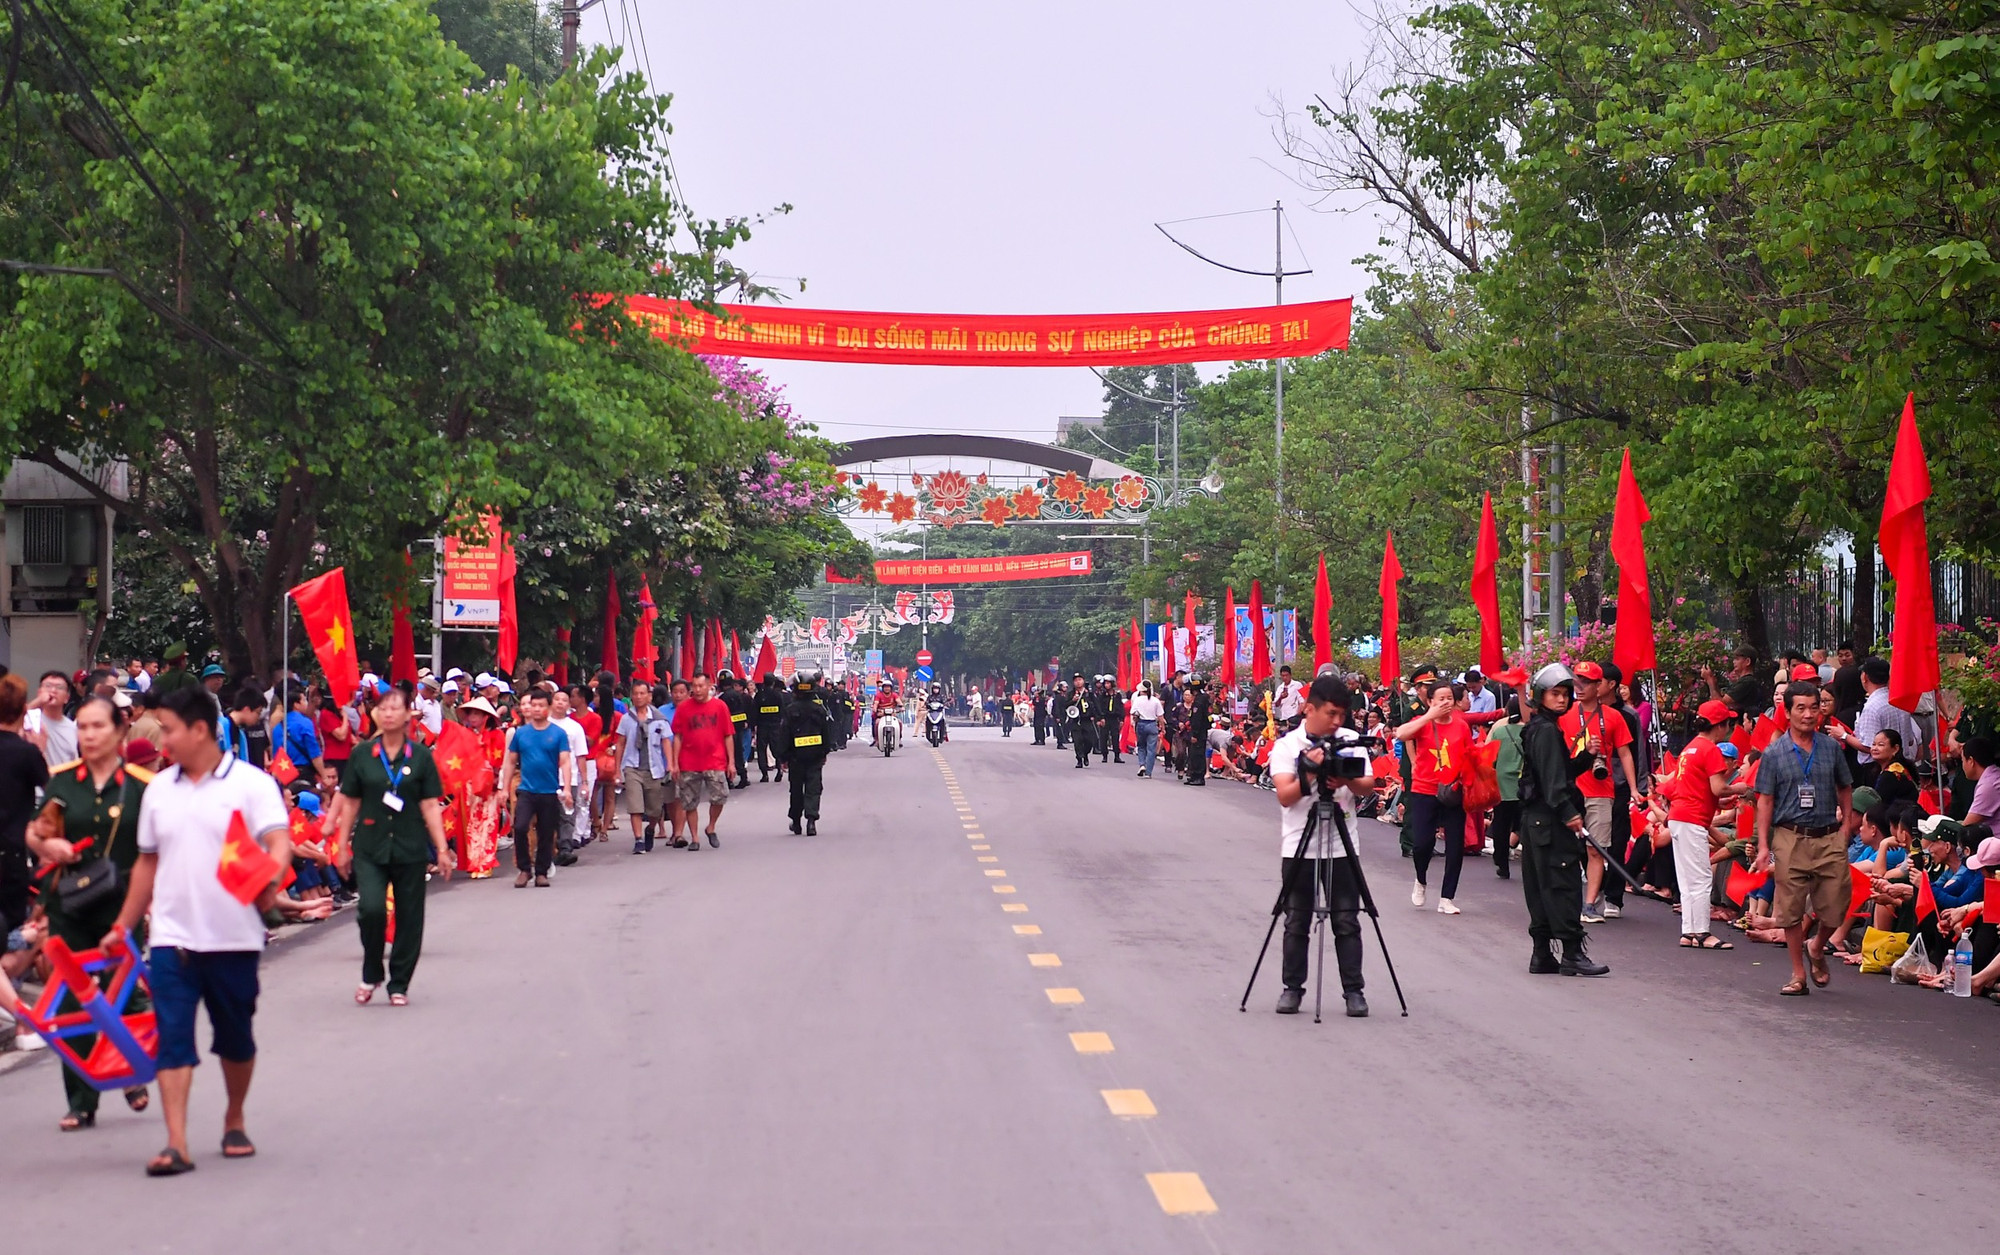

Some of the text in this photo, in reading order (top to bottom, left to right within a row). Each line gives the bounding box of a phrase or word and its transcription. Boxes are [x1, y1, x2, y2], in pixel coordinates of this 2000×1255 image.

[714, 317, 745, 341] CHÍ
[751, 322, 801, 345] MINH
[807, 322, 825, 346] VĨ
[836, 326, 868, 351] ĐẠI
[874, 321, 926, 350] SỐNG
[931, 327, 967, 351] MÃI
[975, 330, 1037, 352] TRONG
[1047, 329, 1075, 355] SỰ
[1083, 325, 1152, 354] NGHIỆP
[1158, 321, 1196, 349] CỦA
[1207, 320, 1271, 346] CHÚNG
[1280, 319, 1309, 342] TA!
